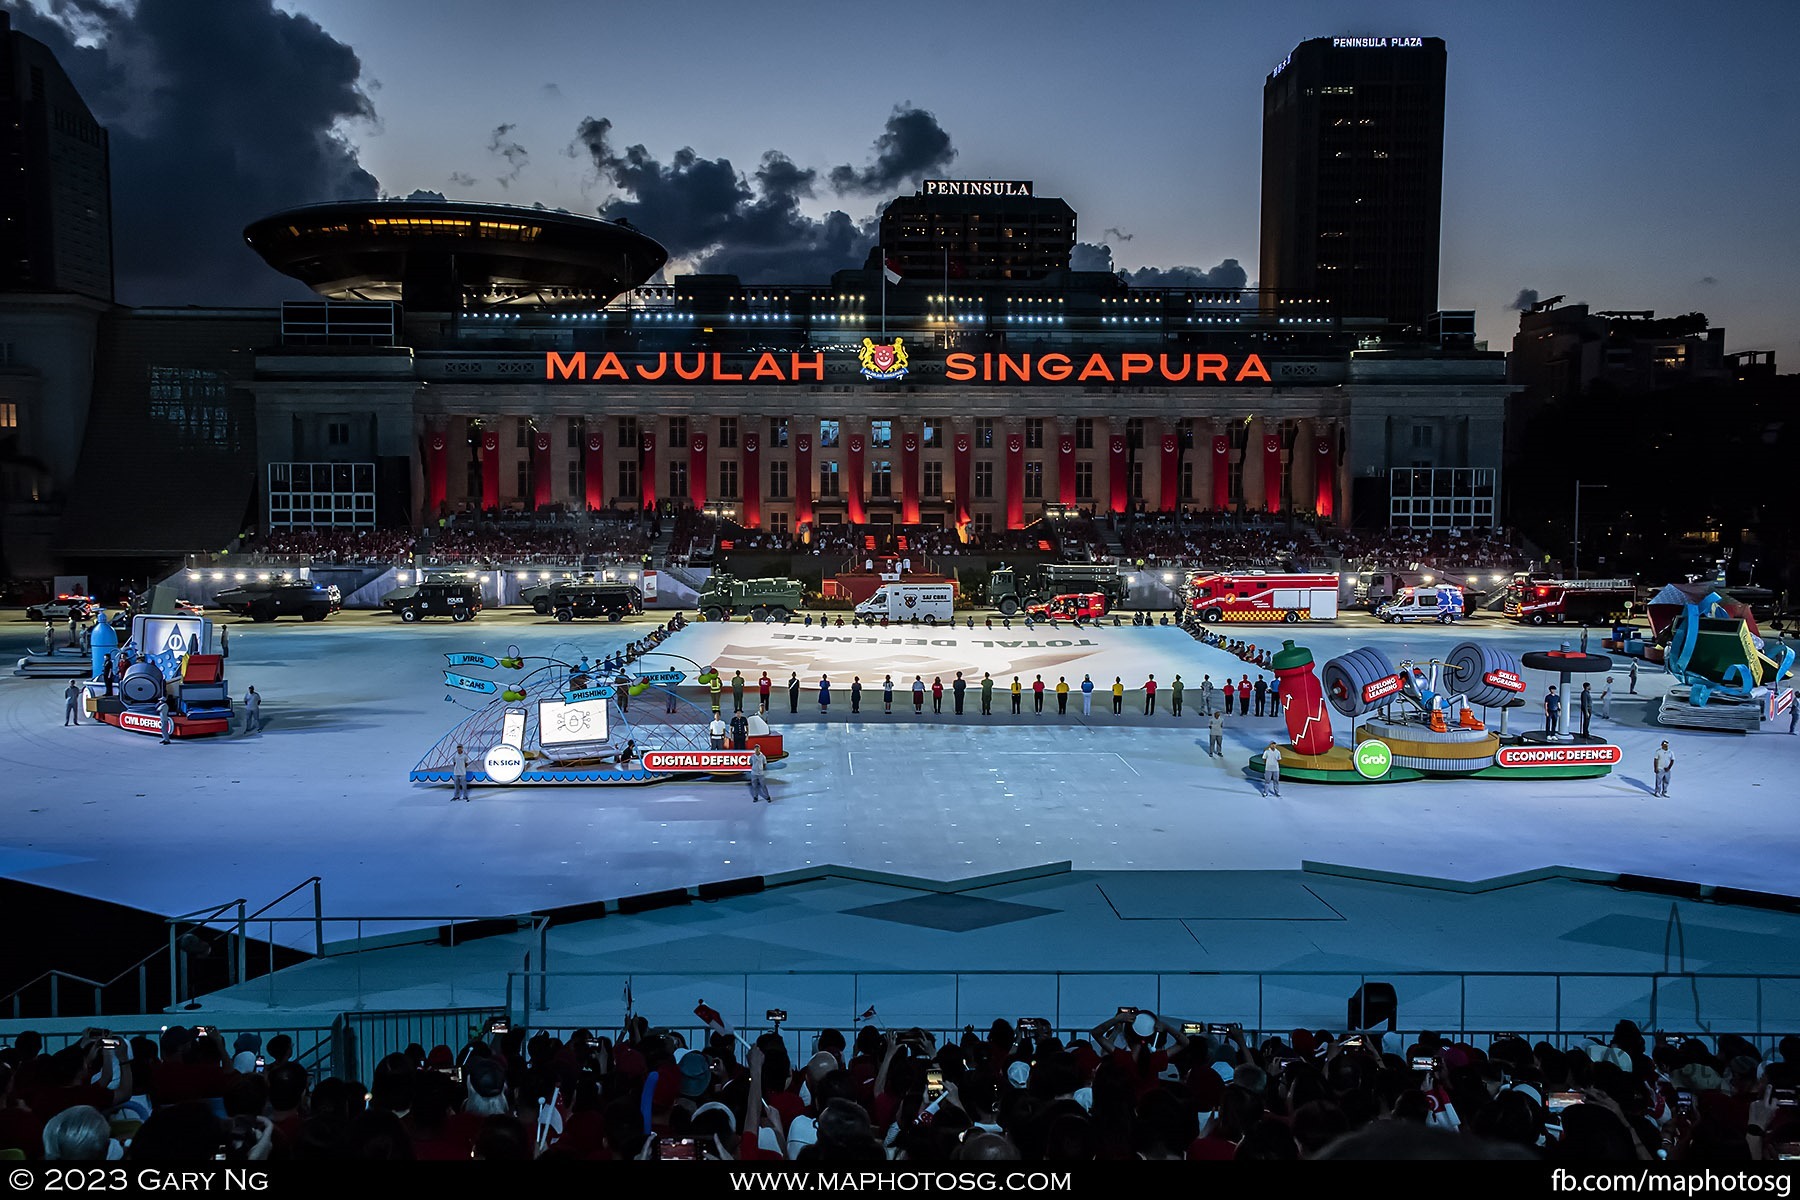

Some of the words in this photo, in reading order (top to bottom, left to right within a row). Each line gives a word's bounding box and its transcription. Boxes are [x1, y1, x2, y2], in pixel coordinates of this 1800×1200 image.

[1333, 38, 1387, 47] PENINSULA
[1391, 37, 1423, 47] PLAZA
[926, 181, 1030, 196] PENINSULA
[546, 351, 824, 381] MAJULAH
[945, 352, 1271, 382] SINGAPURA
[770, 632, 958, 647] DEFENCE
[971, 638, 1099, 648] TOTAL
[462, 655, 485, 664] VIRUS
[660, 673, 680, 681] NEWS
[1498, 671, 1517, 681] SKILLS
[458, 678, 486, 690] SCAMS
[1367, 677, 1396, 693] LIFELONG
[1489, 675, 1523, 690] UPGRADING
[572, 688, 608, 700] PHISHING
[1368, 683, 1398, 699] LEARNING
[124, 715, 140, 726] CIVIL
[139, 718, 163, 730] DEFENC
[652, 755, 699, 767] DIGITAL
[1360, 753, 1387, 765] Grab
[1506, 749, 1566, 762] ECONOMIC
[1566, 748, 1613, 761] DEFENCE
[488, 759, 521, 767] ENSIGN
